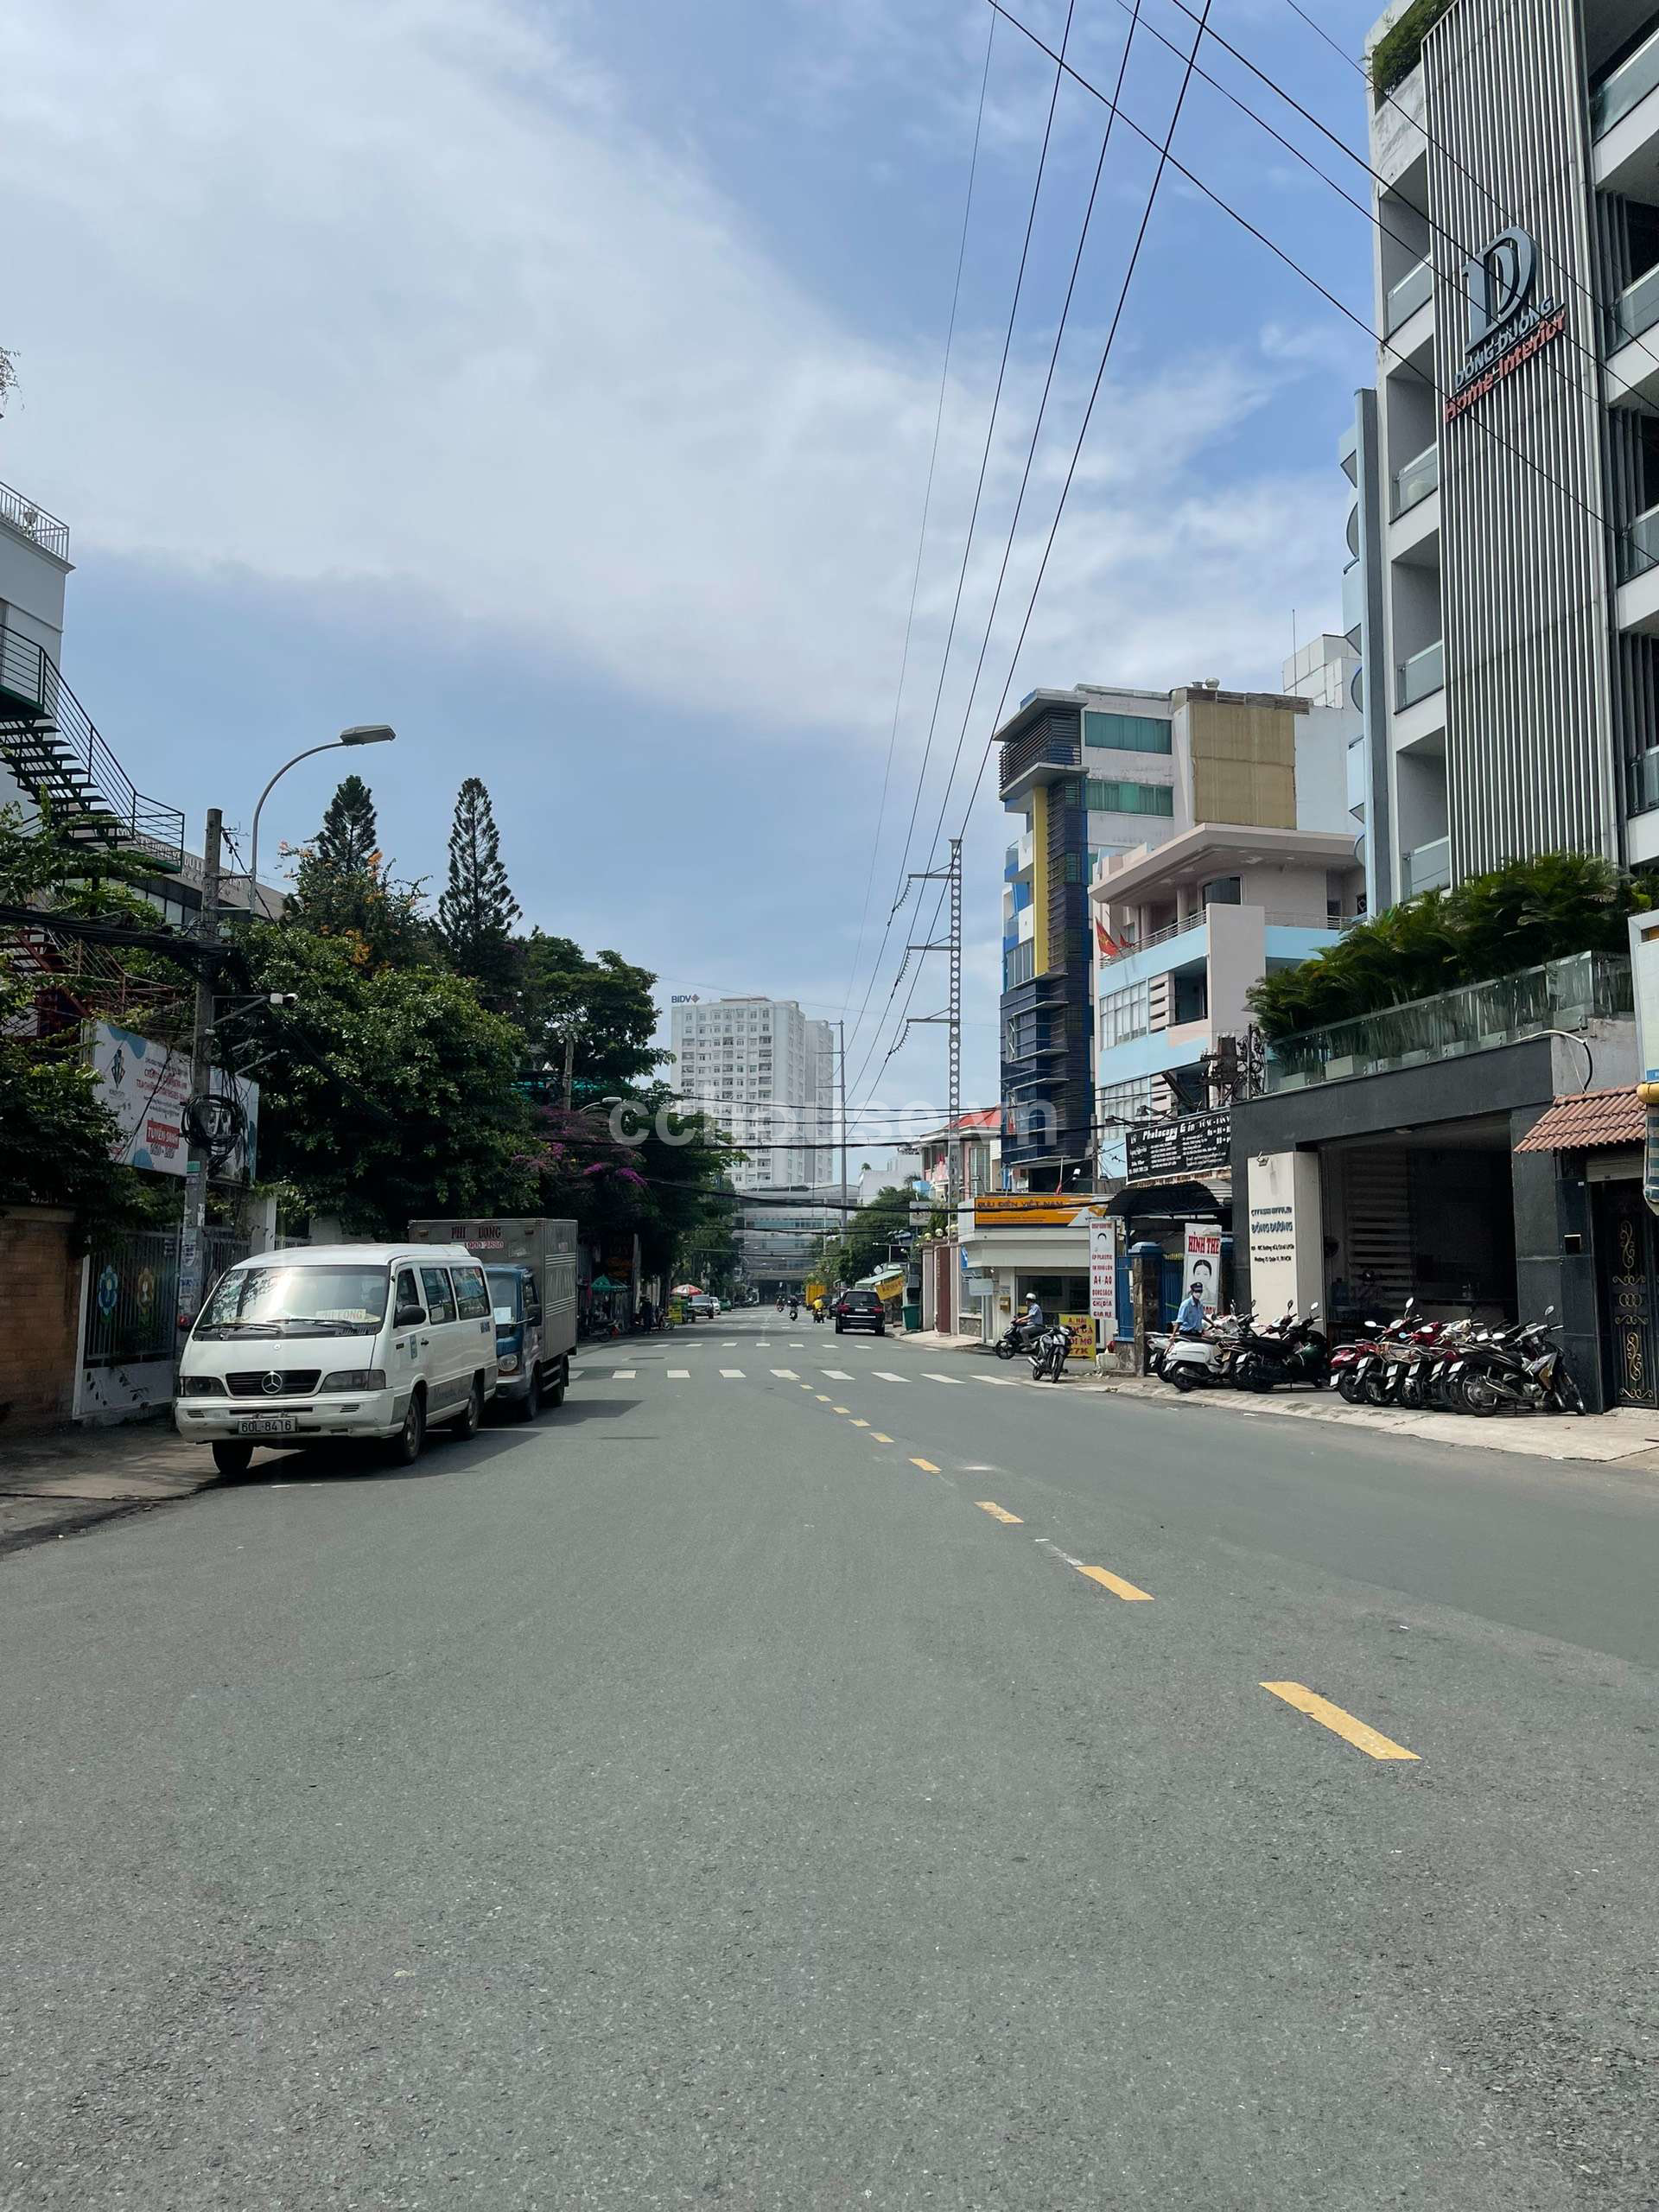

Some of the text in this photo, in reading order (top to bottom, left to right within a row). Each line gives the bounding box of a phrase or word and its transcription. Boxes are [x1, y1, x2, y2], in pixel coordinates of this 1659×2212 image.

[1444, 310, 1567, 423] Home Interior
[671, 995, 691, 1003] BIDV
[242, 1421, 291, 1433] 60L-8416
